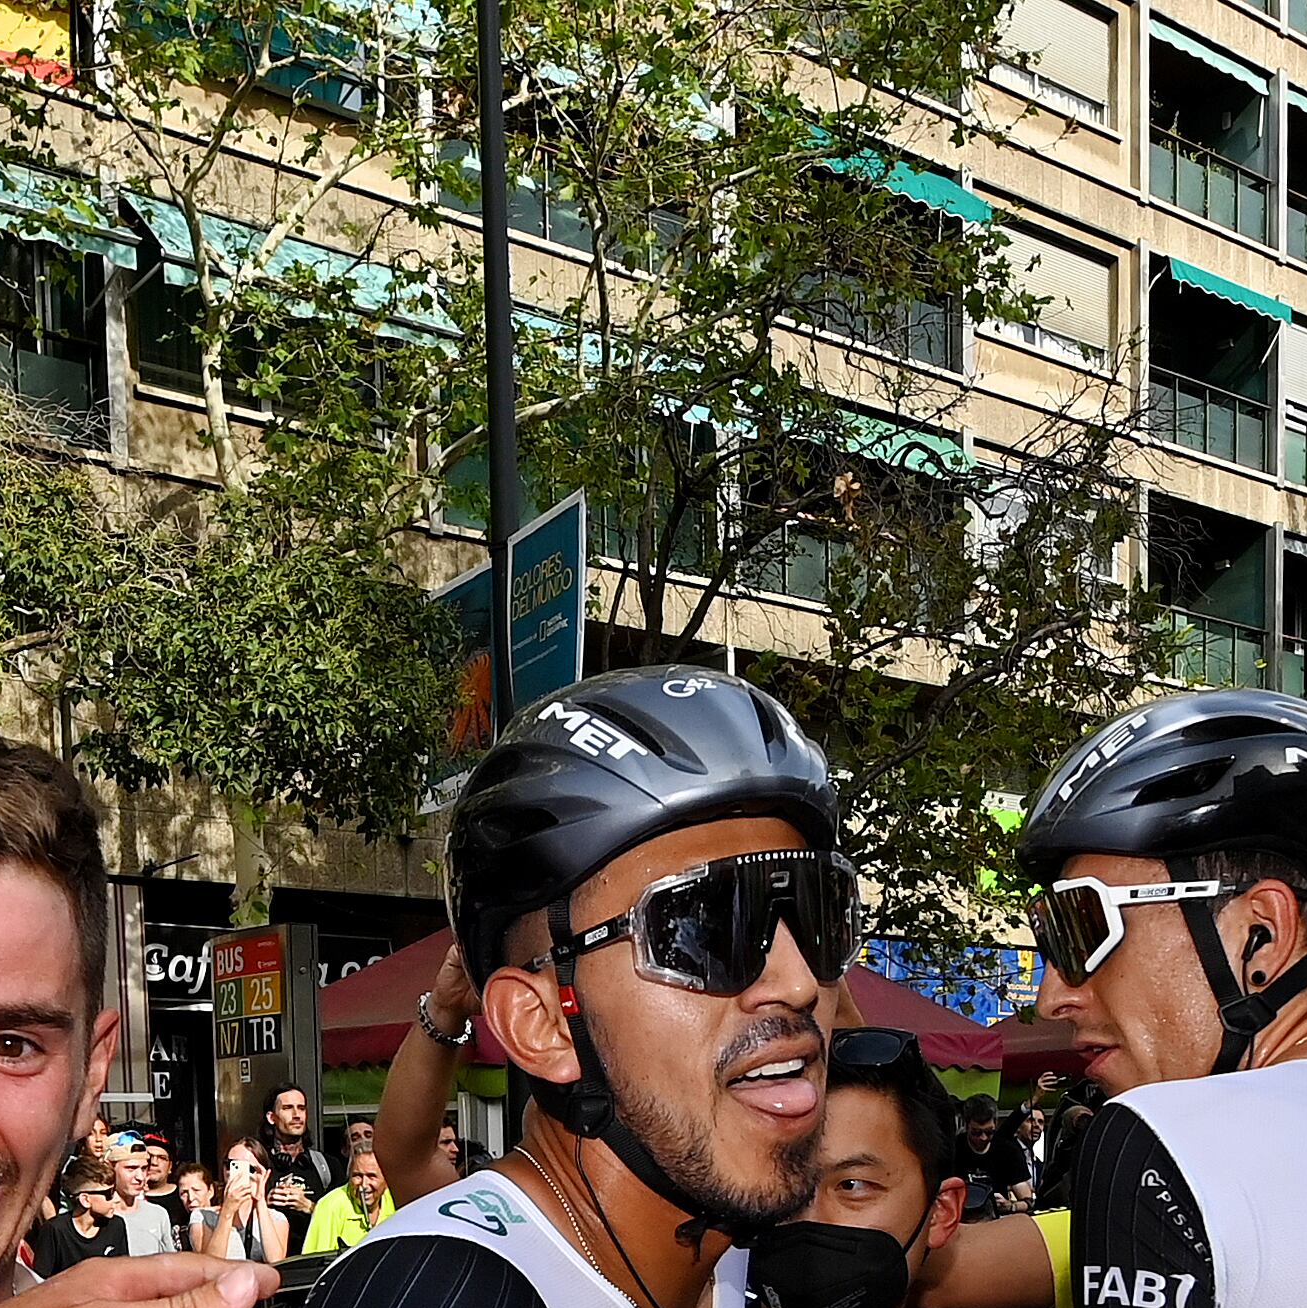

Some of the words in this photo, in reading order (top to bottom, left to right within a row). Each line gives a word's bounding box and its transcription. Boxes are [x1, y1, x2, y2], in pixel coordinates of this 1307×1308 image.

[512, 595, 531, 621] DEL
[532, 567, 573, 611] MUNDO
[513, 551, 563, 598] COLORES
[537, 701, 648, 761] MET
[1058, 708, 1153, 802] MET
[216, 945, 244, 976] BUS
[220, 982, 237, 1015] 23
[250, 977, 273, 1010] 25
[220, 1021, 239, 1055] N7
[248, 1017, 276, 1052] TR
